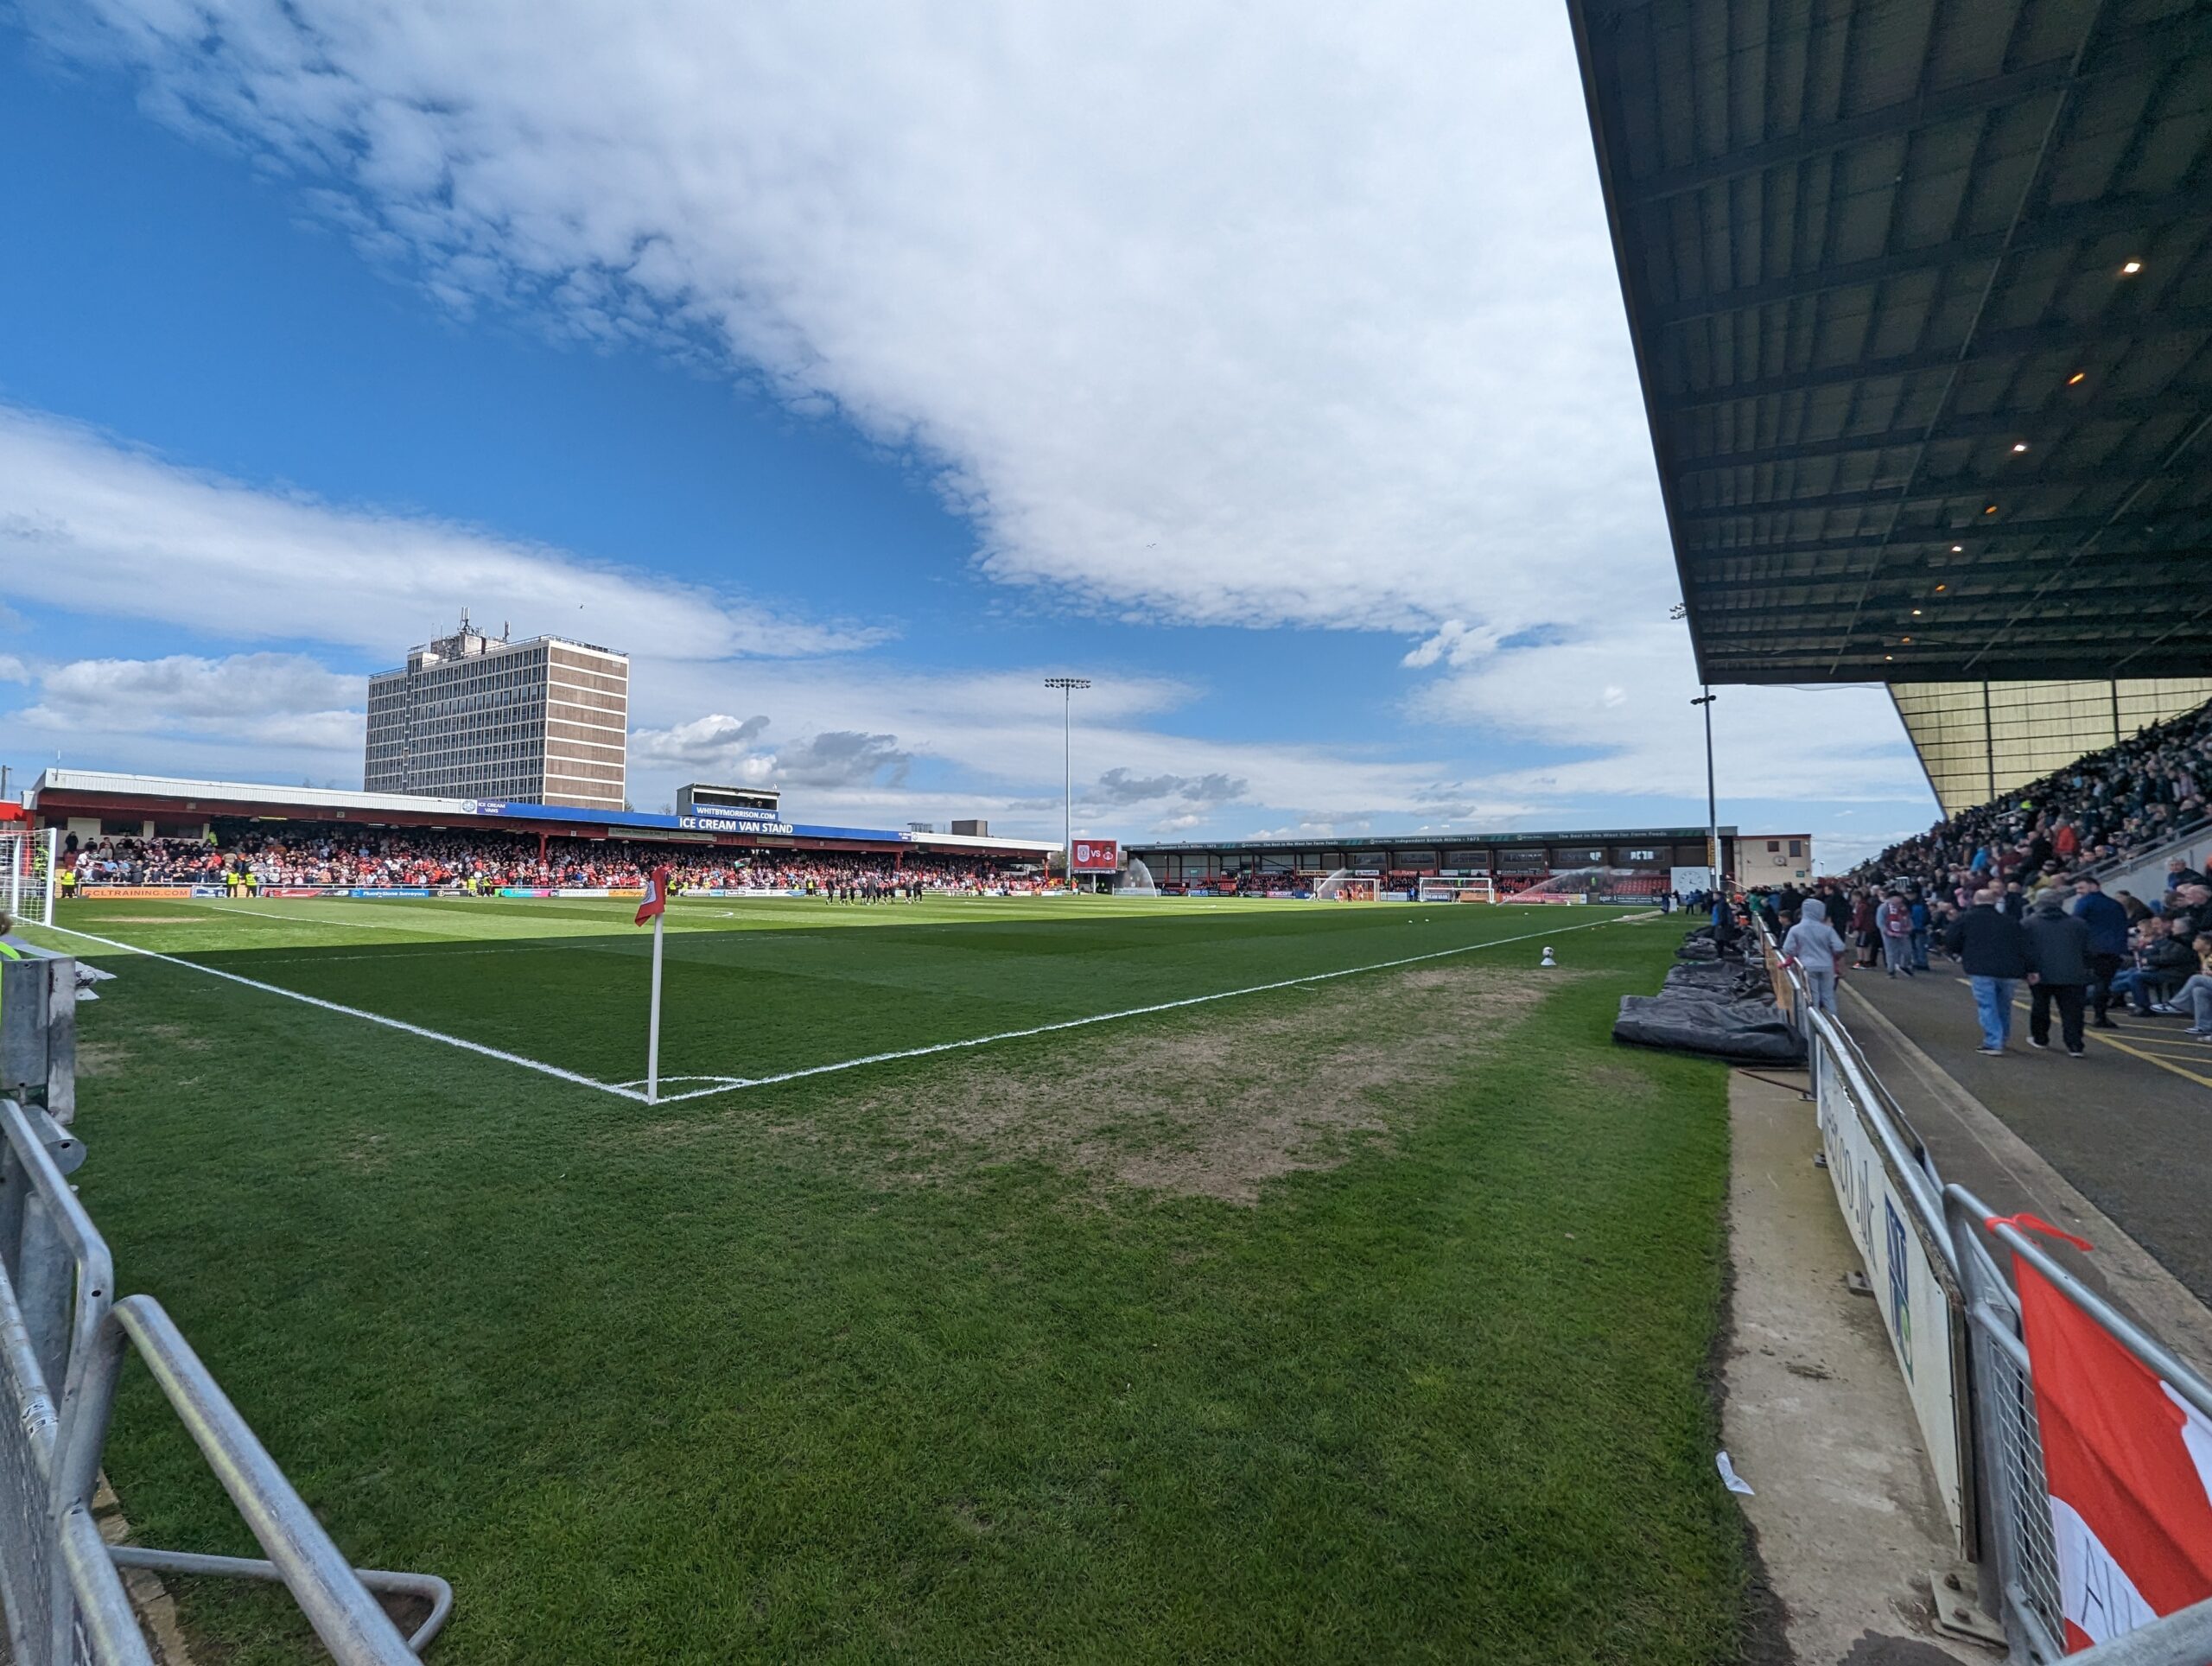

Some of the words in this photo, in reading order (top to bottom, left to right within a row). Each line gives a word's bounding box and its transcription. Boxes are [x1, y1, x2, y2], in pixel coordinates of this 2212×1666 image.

[696, 806, 776, 820] WHITBYMORRISON.COM
[679, 817, 696, 829] ICE
[698, 818, 736, 830] CREAM
[739, 821, 760, 831] VAN
[762, 823, 793, 834] STAND
[1090, 849, 1101, 858] VS
